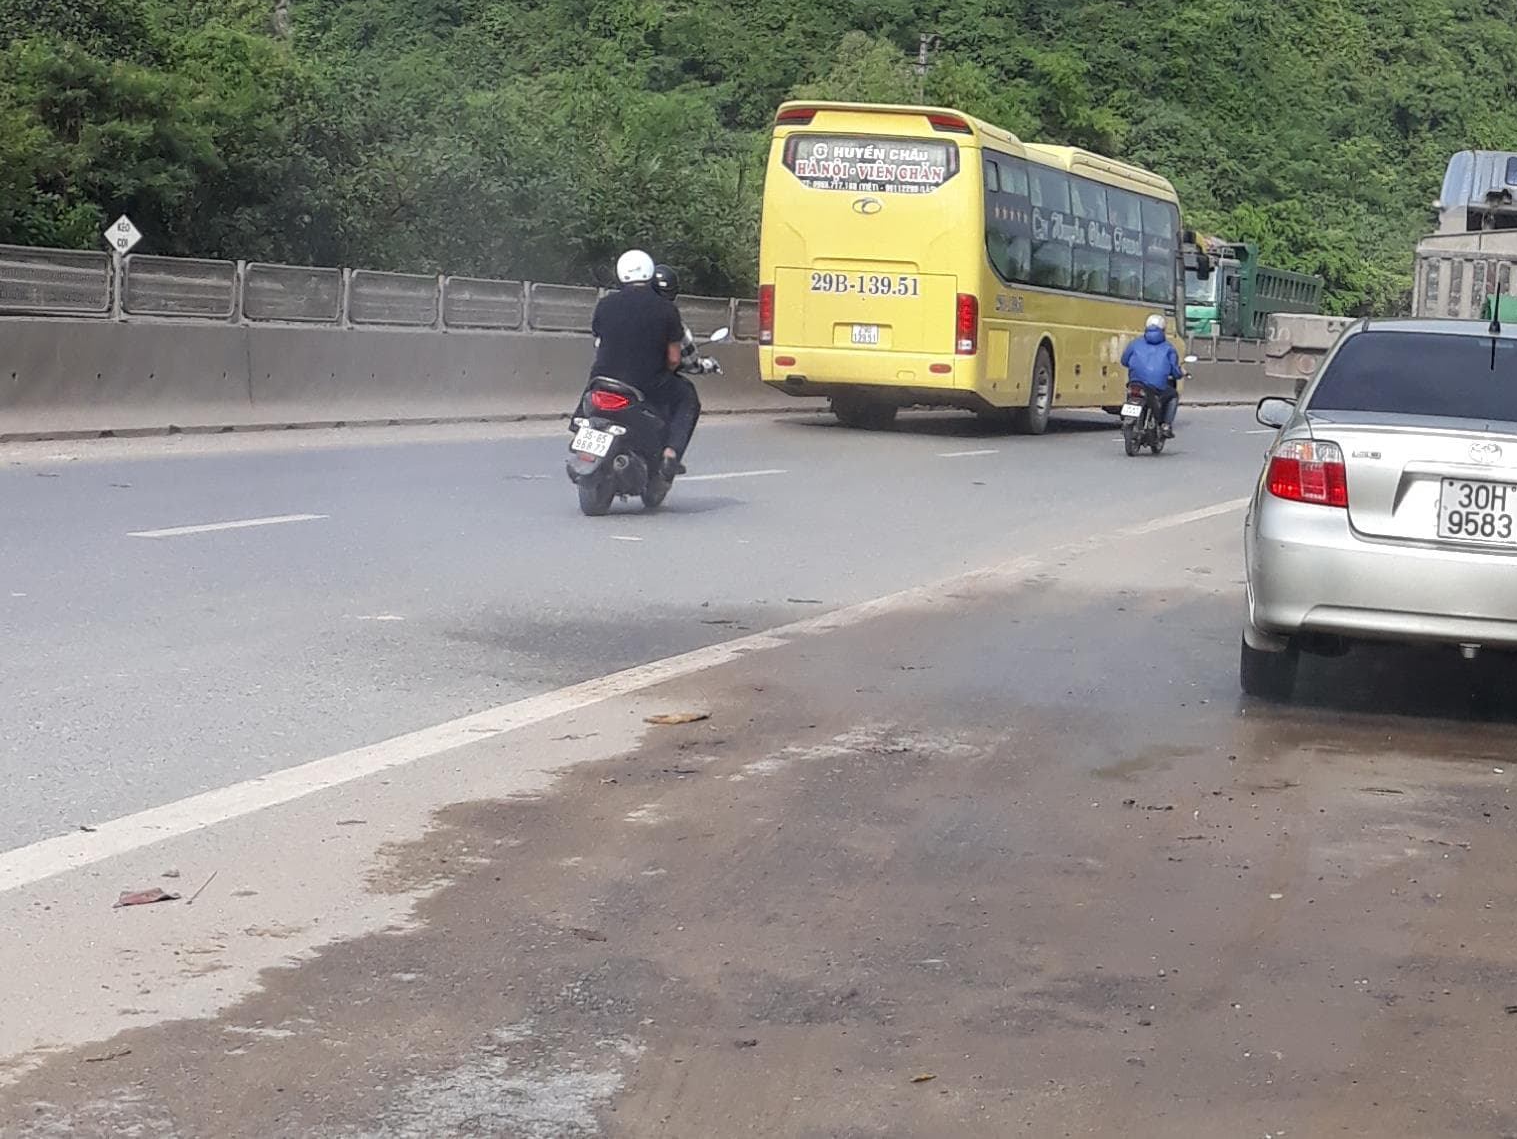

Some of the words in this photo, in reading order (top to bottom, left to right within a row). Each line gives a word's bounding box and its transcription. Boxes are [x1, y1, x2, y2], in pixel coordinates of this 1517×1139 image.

[811, 272, 919, 296] 29B-139.51
[1458, 483, 1507, 511] 30H
[1447, 510, 1513, 538] 9583
